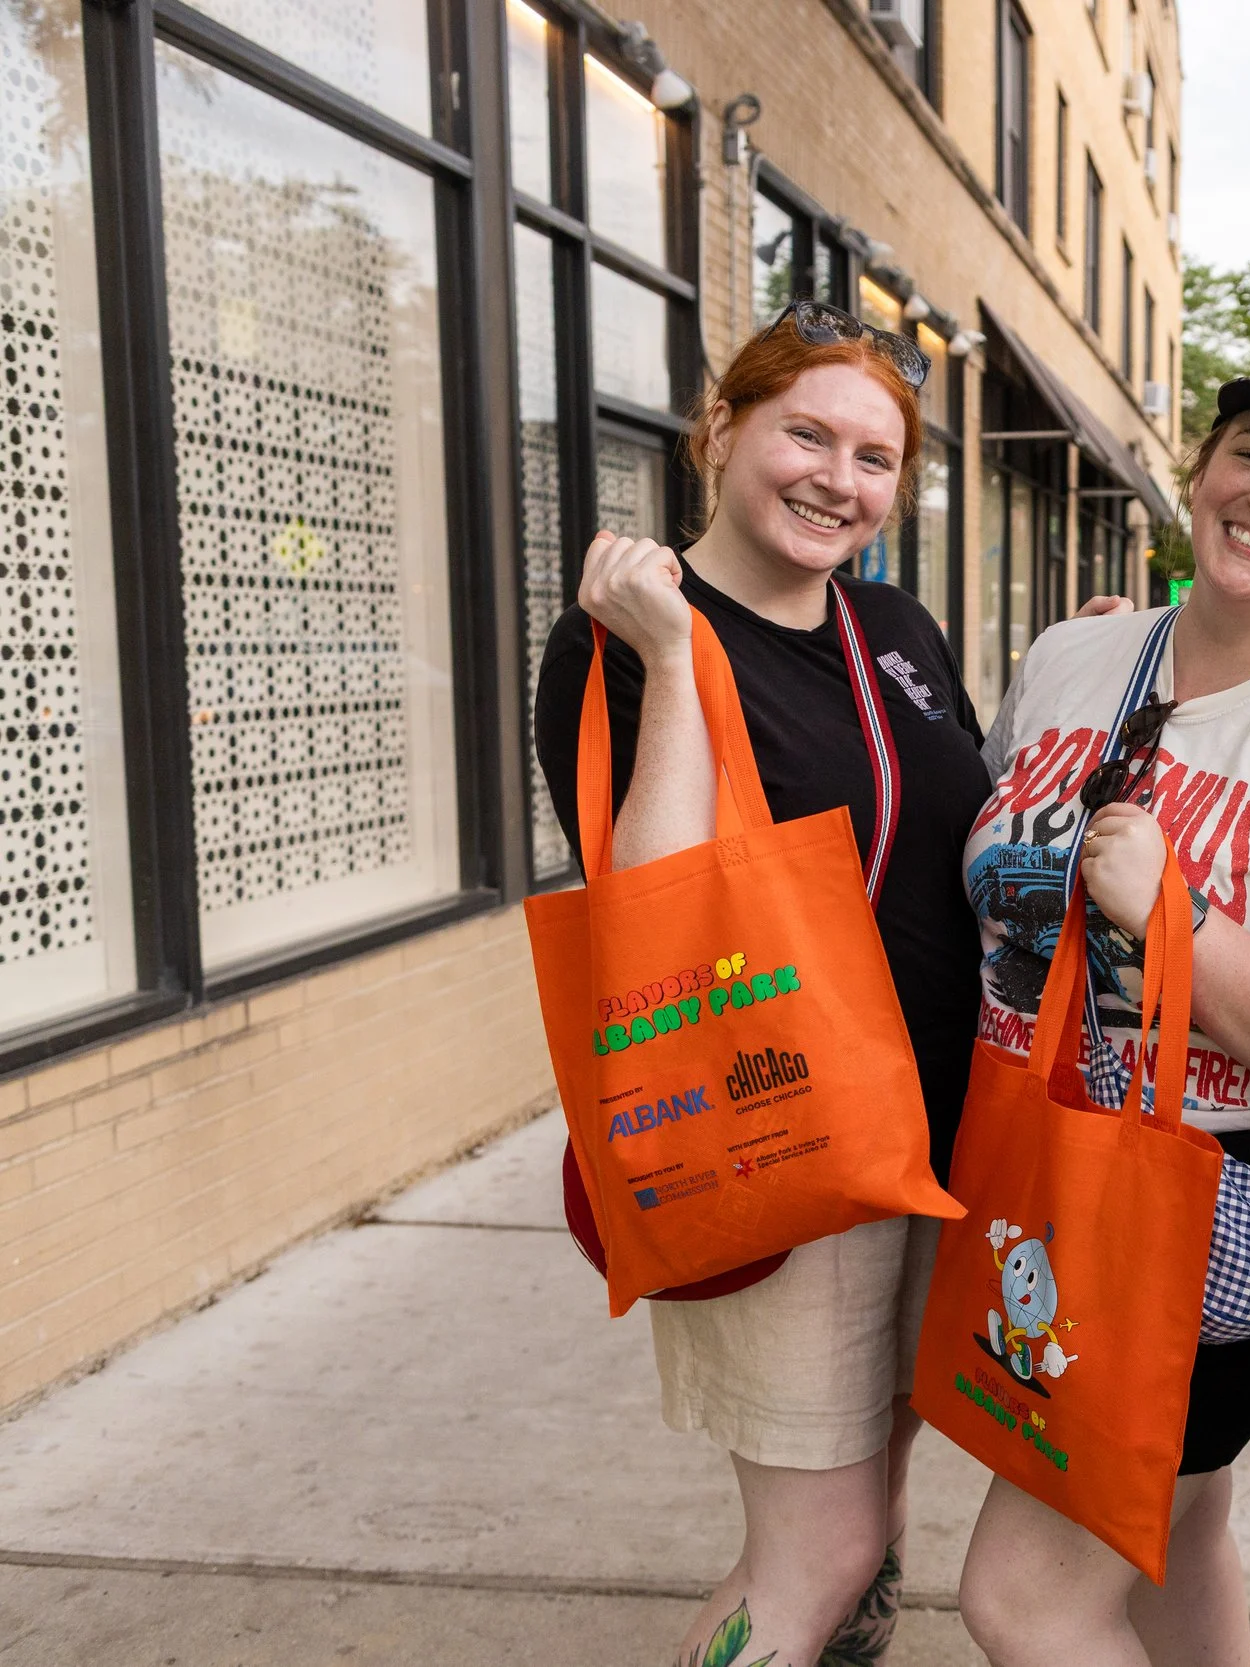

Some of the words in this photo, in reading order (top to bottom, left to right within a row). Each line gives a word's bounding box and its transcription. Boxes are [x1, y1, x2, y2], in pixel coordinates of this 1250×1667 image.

[598, 963, 714, 1022] FLAVORS
[715, 952, 748, 981] OF
[592, 994, 702, 1058] LBANY
[708, 965, 802, 1016] PARK
[725, 1047, 810, 1102] CHICAGO
[1121, 1039, 1159, 1083] AN
[1185, 1047, 1250, 1107] FIRE!
[634, 1086, 644, 1094] BY
[735, 1098, 772, 1115] CHOOSE
[774, 1085, 812, 1104] CHICAGO
[608, 1085, 712, 1143] ALBANK
[727, 1143, 743, 1153] WITH
[743, 1134, 770, 1150] SUPPORT
[771, 1128, 789, 1140] FROM
[756, 1152, 778, 1164] Albany
[778, 1147, 792, 1156] Park
[798, 1139, 816, 1149] Irving
[816, 1135, 830, 1144] Park
[758, 1158, 780, 1169] Special
[781, 1150, 804, 1161] Service
[804, 1145, 819, 1154] Area
[627, 1172, 654, 1185] BROUGHT
[654, 1169, 663, 1177] TO
[676, 1162, 684, 1170] BY
[654, 1178, 688, 1194] NORTH
[689, 1170, 718, 1184] RIVER
[659, 1180, 719, 1205] COMMISSION
[954, 1372, 1017, 1432] ALBANY
[1022, 1421, 1068, 1472] PARK
[1031, 1410, 1046, 1431] OF
